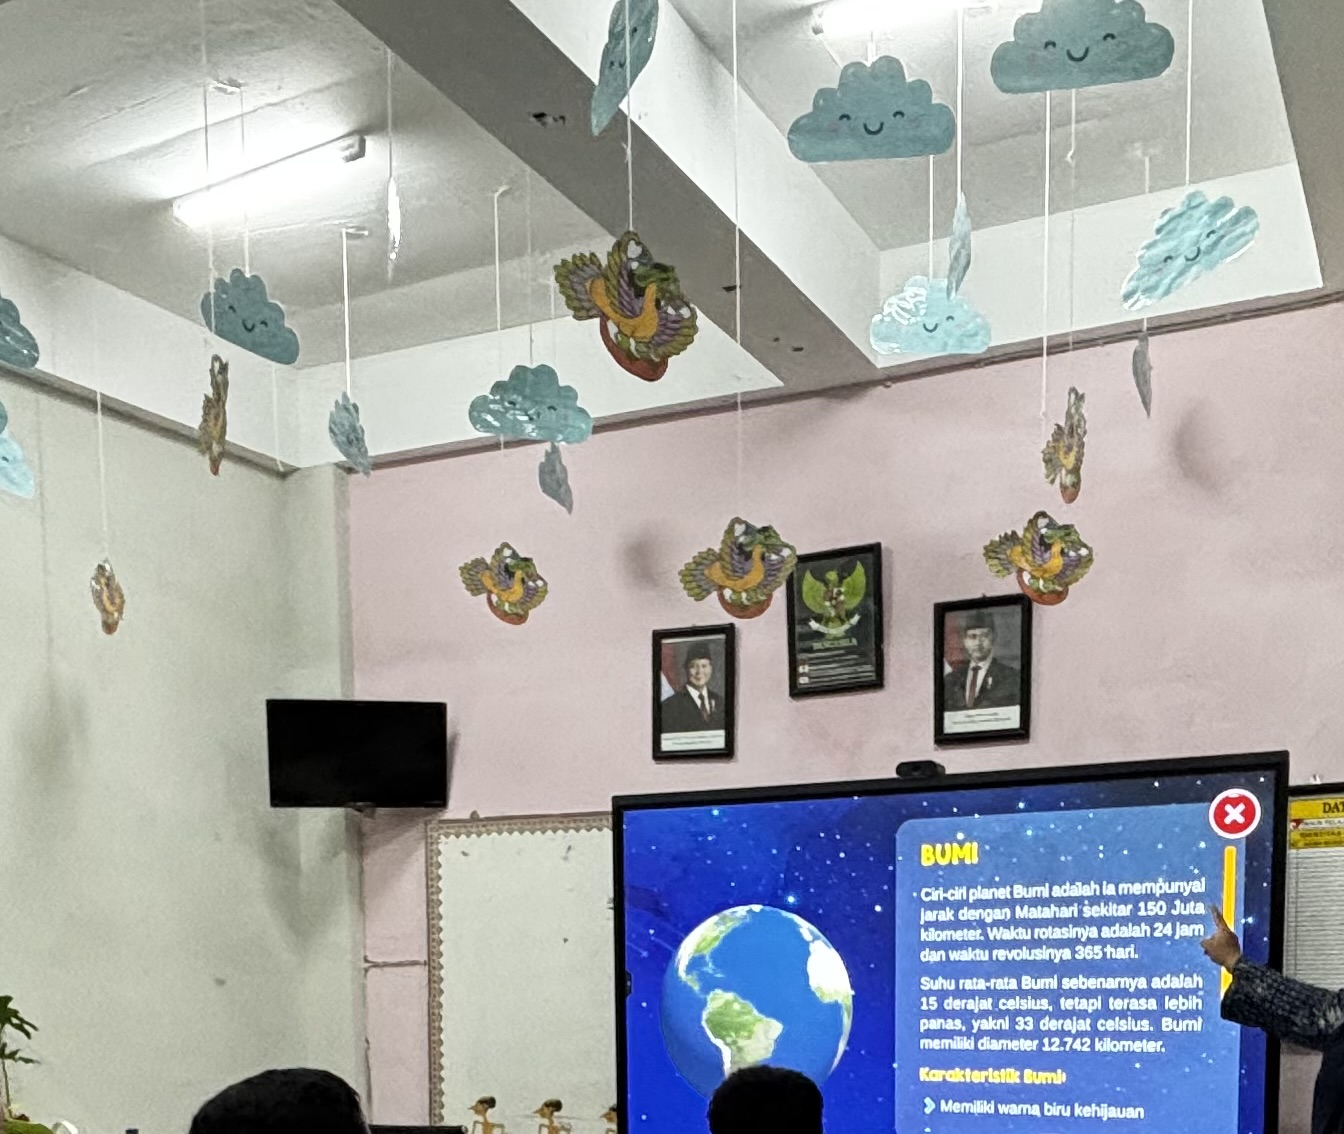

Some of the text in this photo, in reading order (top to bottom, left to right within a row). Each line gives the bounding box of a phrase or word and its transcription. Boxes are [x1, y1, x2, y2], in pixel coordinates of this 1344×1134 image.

[920, 842, 978, 867] BUMI
[969, 885, 1011, 903] planet
[1013, 883, 1049, 898] Bumi
[1052, 881, 1100, 897] adalah
[1118, 877, 1206, 898] mempunyai
[920, 906, 955, 925] jarak
[958, 905, 1011, 924] dengan
[1015, 903, 1078, 920] Matahari
[1082, 901, 1132, 918] sekitar
[1137, 901, 1166, 917] 150
[920, 928, 985, 942] kilometer.
[986, 926, 1032, 941] Waktu
[1034, 925, 1098, 943] rotasinya
[1101, 923, 1151, 939] adalah
[1153, 922, 1173, 937] 24
[920, 944, 1139, 964] dan waktu revolusinya 365 hari.
[920, 973, 1203, 992] Suhu rata-rata Bumi sebenarnya adalah
[920, 995, 1203, 1013] 15 derajat celsius, tetapi terasa lebih
[919, 1016, 1203, 1034] panas, yakni 33 derajat celsius. Bumi
[919, 1035, 1166, 1053] memiliki diameter 12.742 kilometer.
[919, 1067, 1020, 1083] Karakteristik
[940, 1099, 1144, 1120] Memiliki warna biru kehijauan
